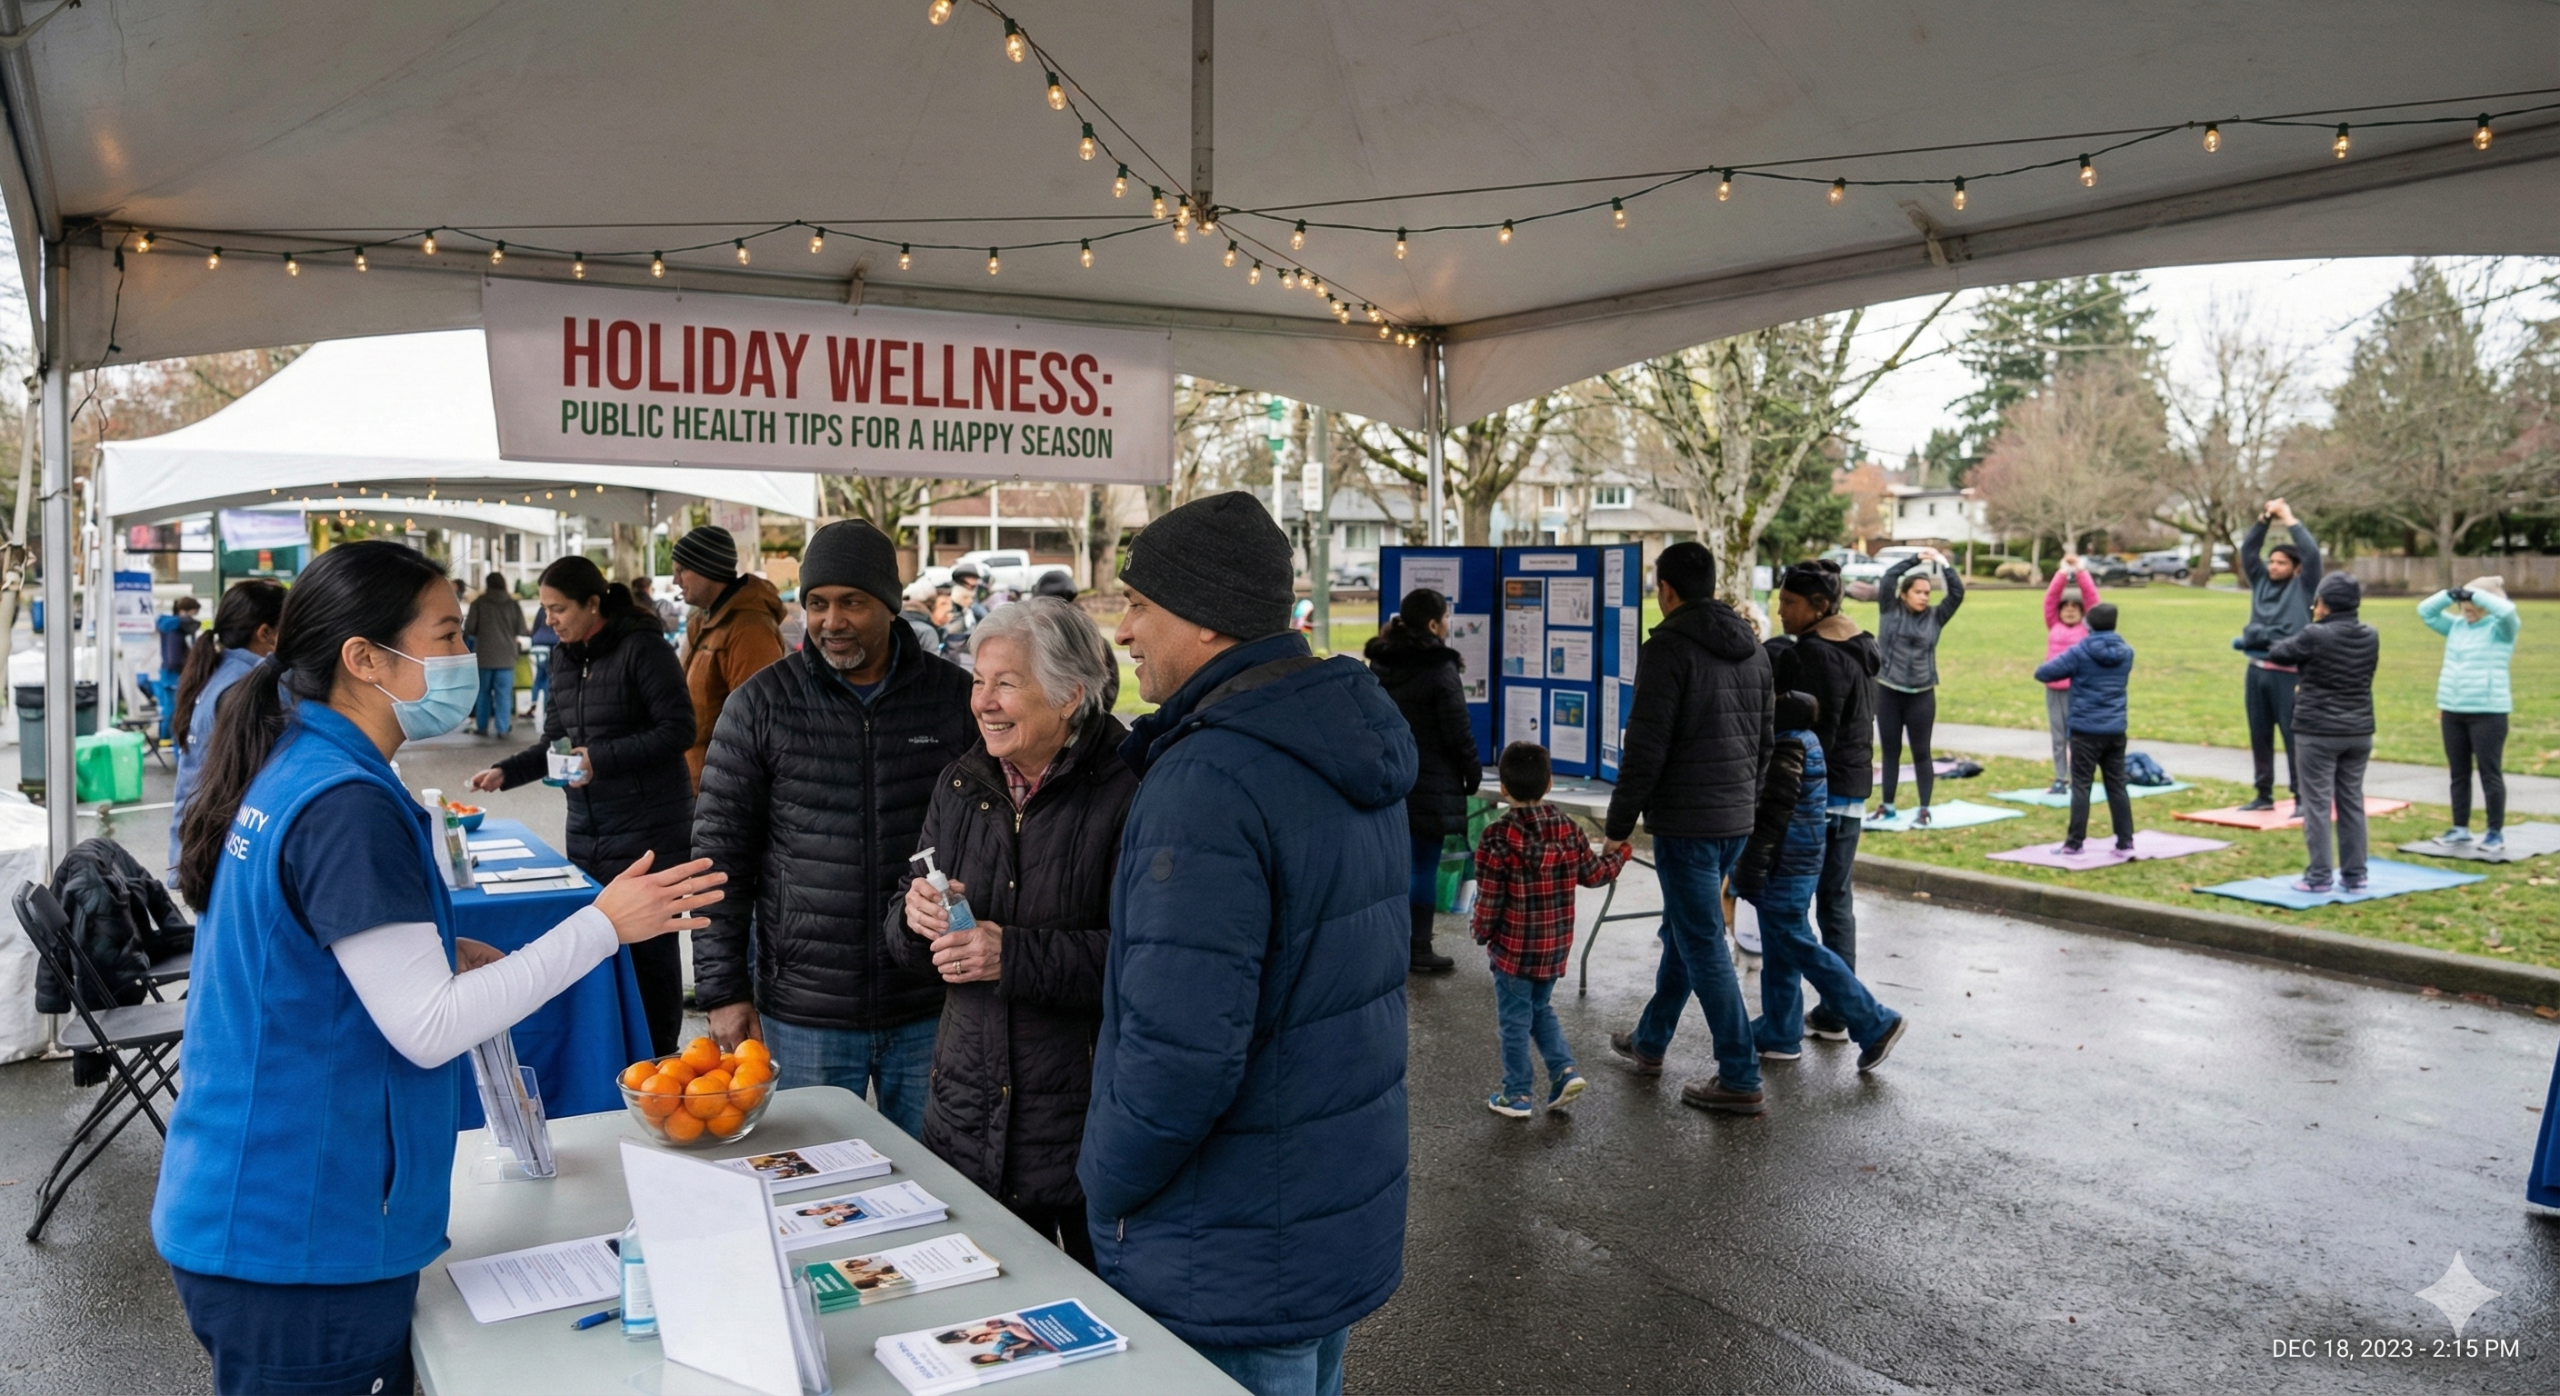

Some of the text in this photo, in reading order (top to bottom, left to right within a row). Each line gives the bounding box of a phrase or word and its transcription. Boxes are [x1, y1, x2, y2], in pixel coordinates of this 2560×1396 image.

[562, 316, 1113, 418] HOLIDAY WELLNESS:
[561, 400, 1113, 460] PUBLIC HEALTH TIPS FOR A HAPPY SEASON
